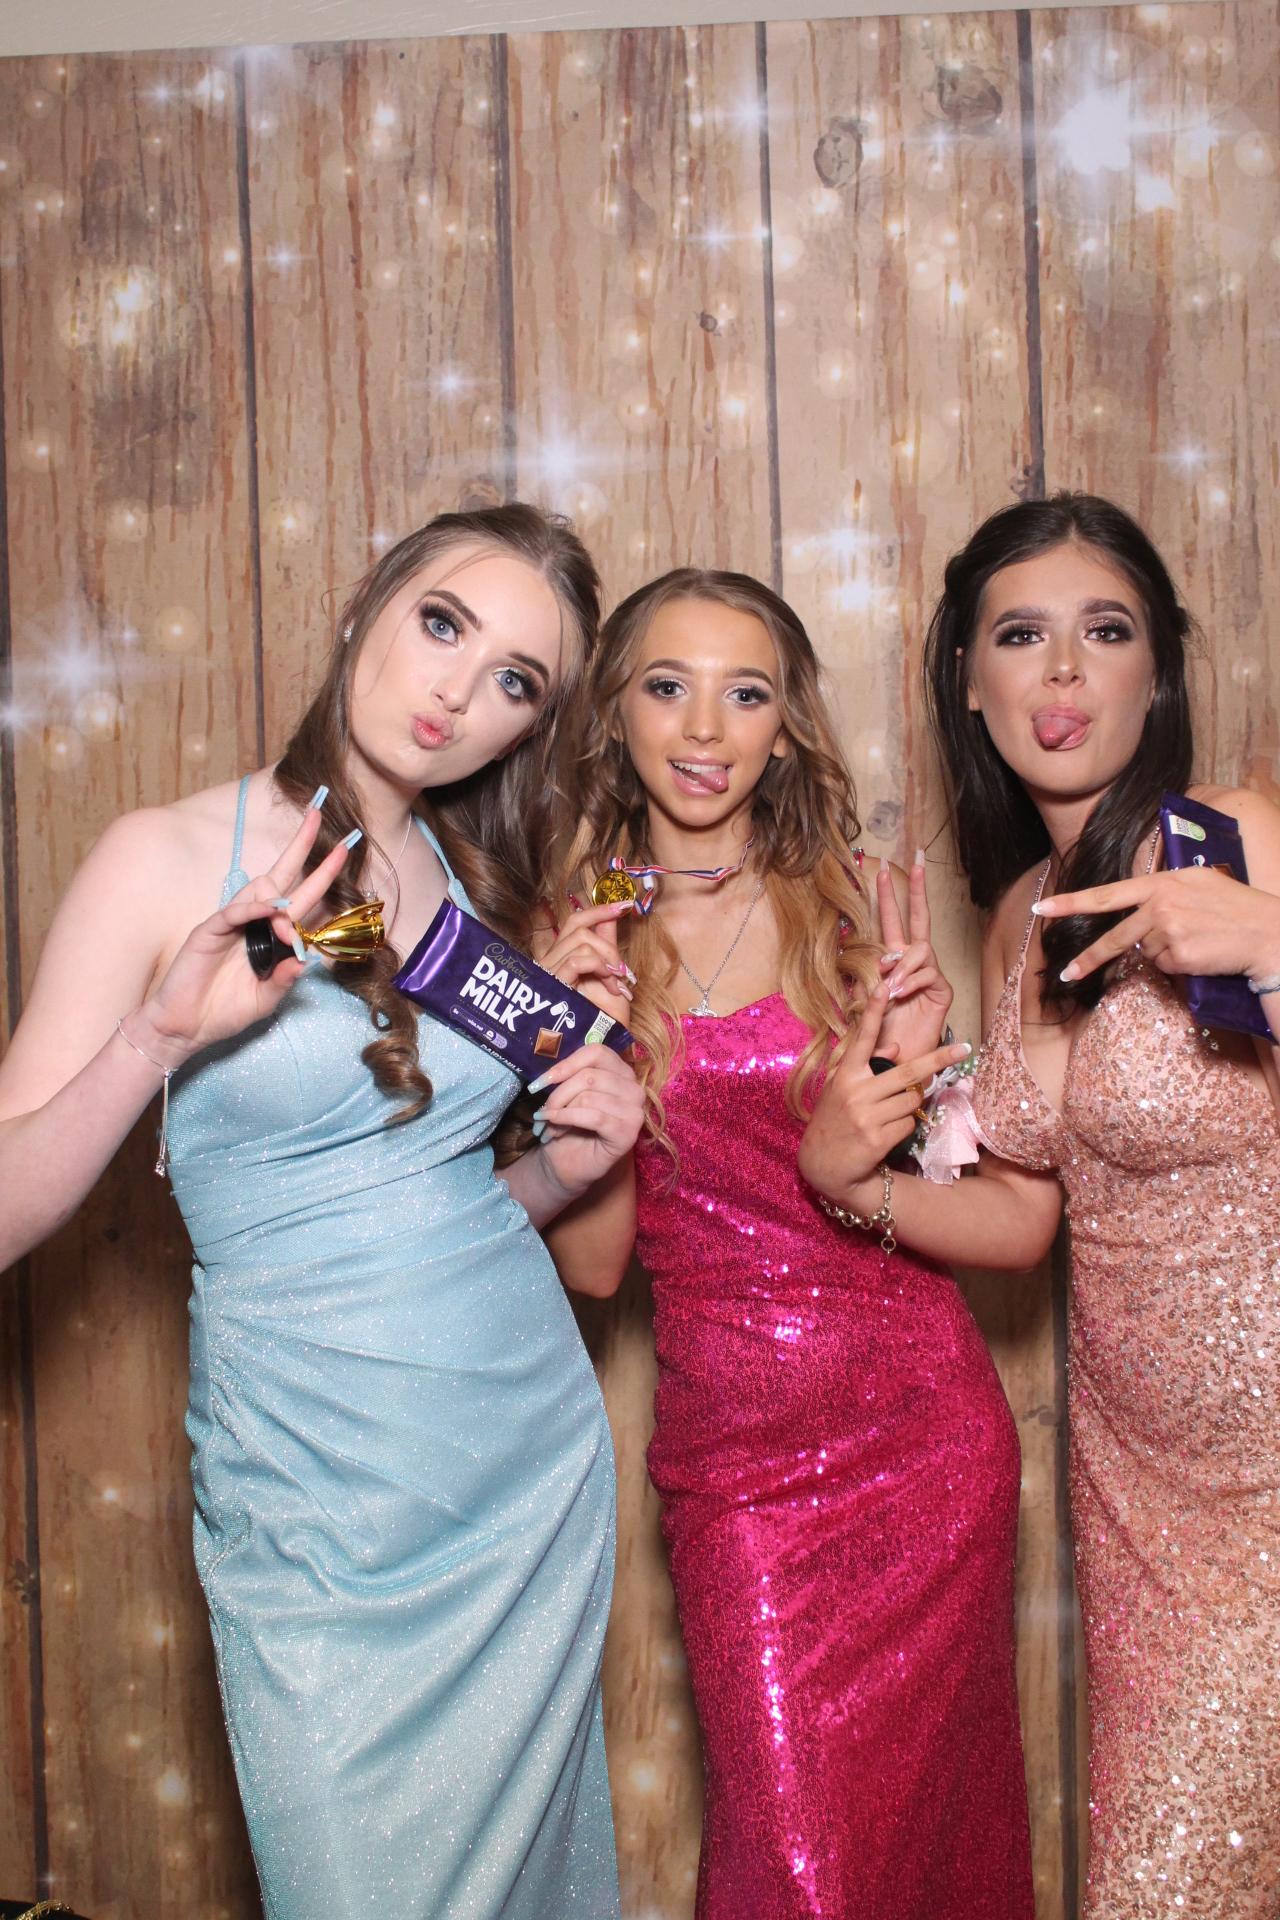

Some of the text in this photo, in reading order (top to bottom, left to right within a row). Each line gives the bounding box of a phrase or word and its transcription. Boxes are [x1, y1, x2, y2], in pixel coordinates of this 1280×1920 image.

[472, 956, 551, 1015] DAIRY
[484, 943, 529, 981] Cadbury
[460, 977, 524, 1032] MILK
